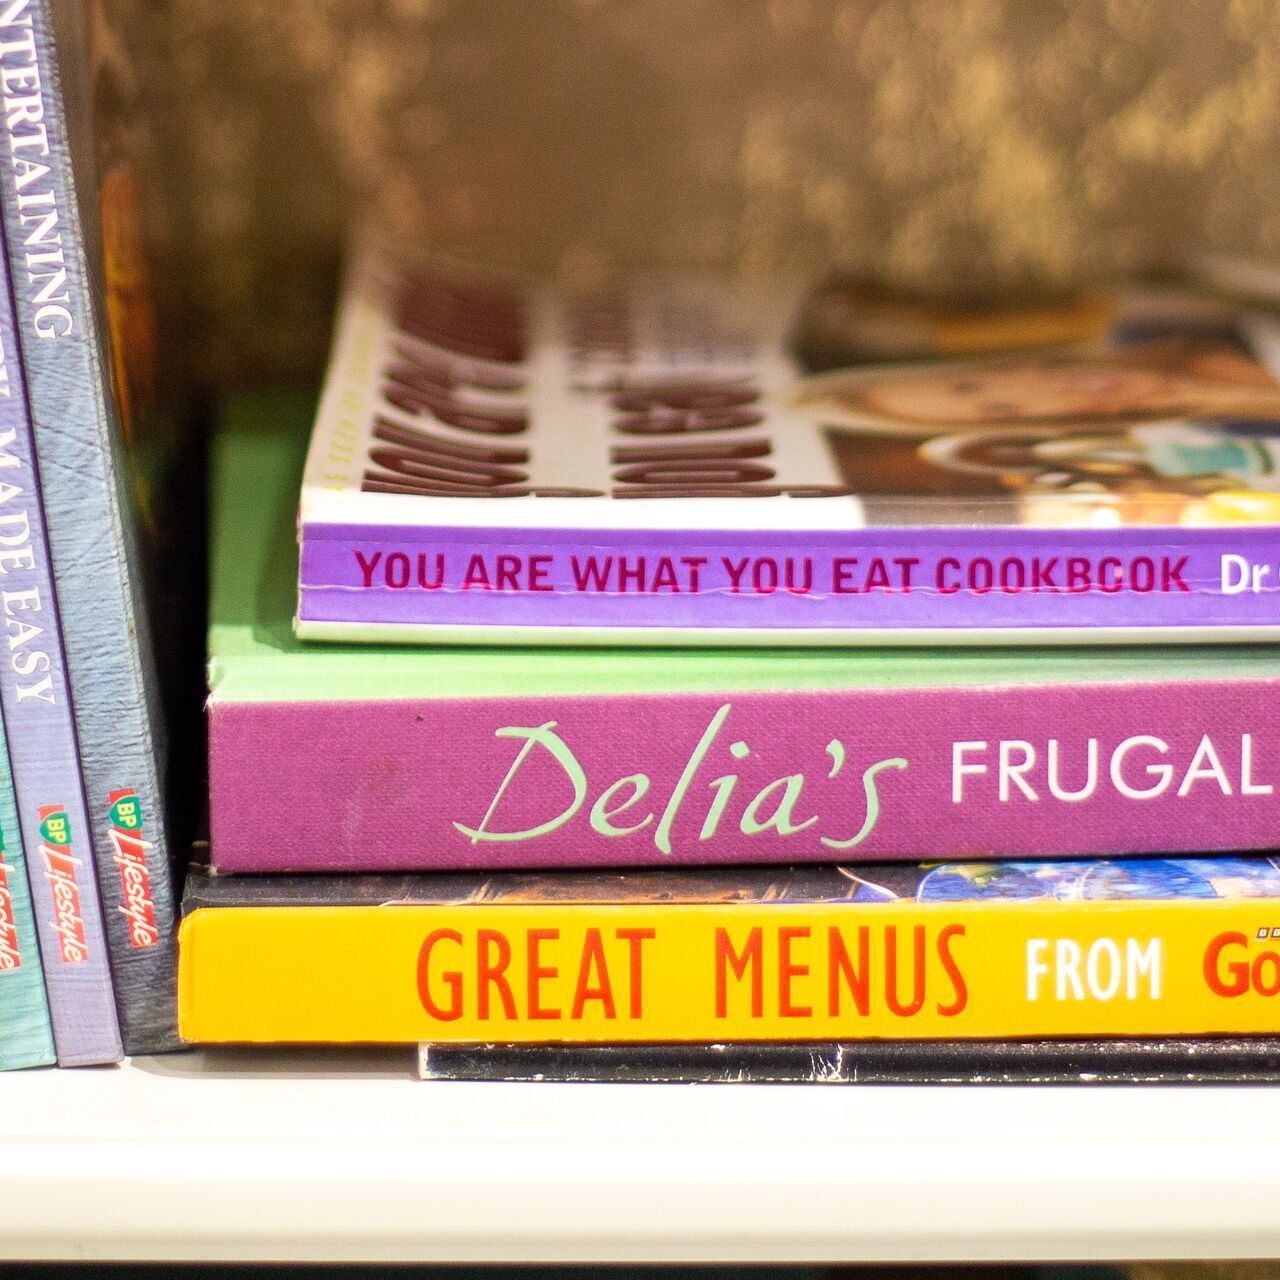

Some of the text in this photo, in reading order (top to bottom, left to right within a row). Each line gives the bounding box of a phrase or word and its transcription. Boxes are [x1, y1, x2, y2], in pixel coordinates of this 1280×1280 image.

[354, 550, 445, 591] YOU
[461, 554, 553, 593] ARE
[571, 556, 708, 595] WHAT
[722, 557, 814, 597] YOU
[832, 557, 920, 595] EAT
[1220, 553, 1271, 596] Dr
[0, 587, 56, 707] EASY
[452, 702, 909, 855] Delia's
[950, 732, 1274, 804] FRUGAL
[38, 816, 88, 961] BP Lifestyle
[108, 802, 157, 947] BP Lifestyle
[415, 926, 656, 1023] GREAT
[714, 922, 970, 1021] MENUS
[1025, 936, 1162, 1002] FROM
